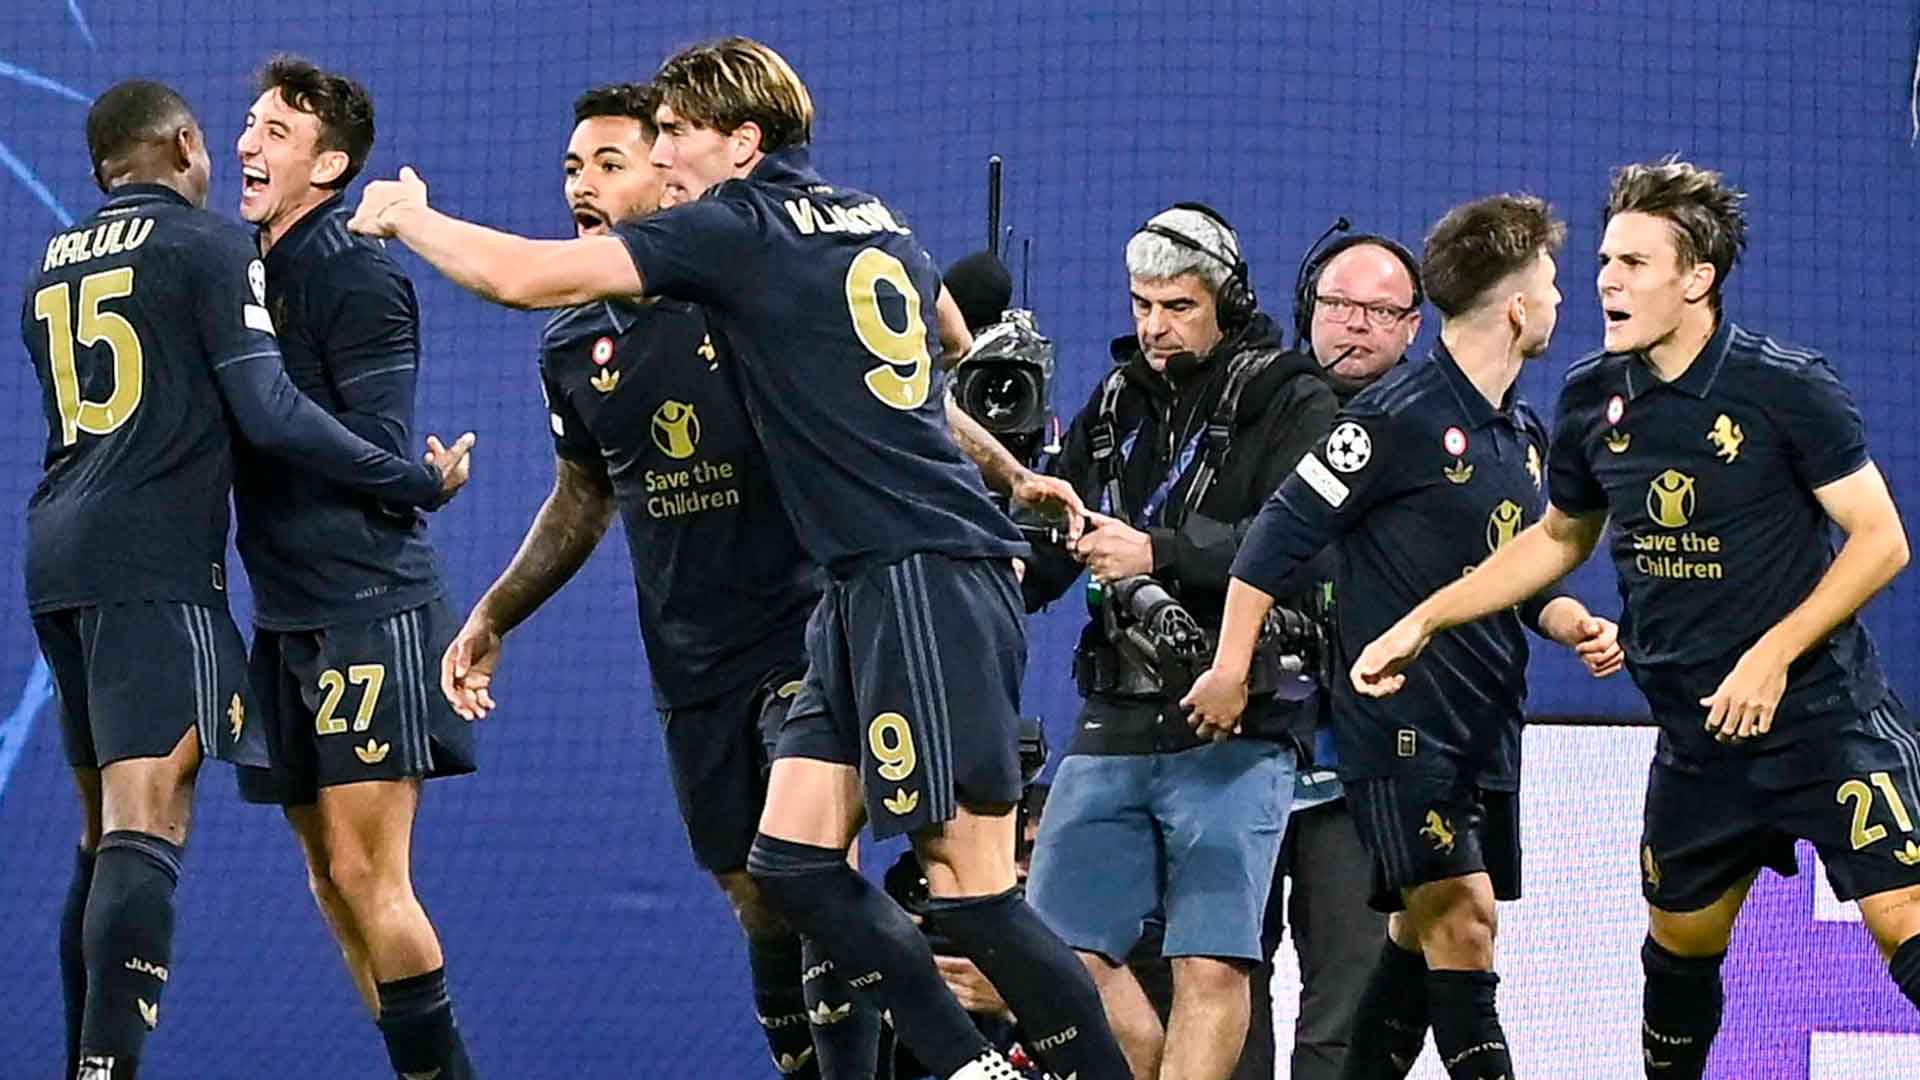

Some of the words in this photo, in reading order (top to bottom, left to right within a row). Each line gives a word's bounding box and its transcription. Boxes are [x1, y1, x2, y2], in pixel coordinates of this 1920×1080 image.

[43, 218, 155, 273] KALULU
[35, 266, 143, 447] 15
[846, 247, 932, 411] 9
[644, 470, 690, 493] Save
[693, 461, 734, 484] the
[647, 488, 740, 519] Children
[1633, 533, 1677, 553] Save
[1681, 532, 1721, 553] the
[1636, 553, 1723, 579] Children
[315, 664, 385, 735] 27
[868, 712, 917, 782] 9
[1836, 772, 1914, 850] 21
